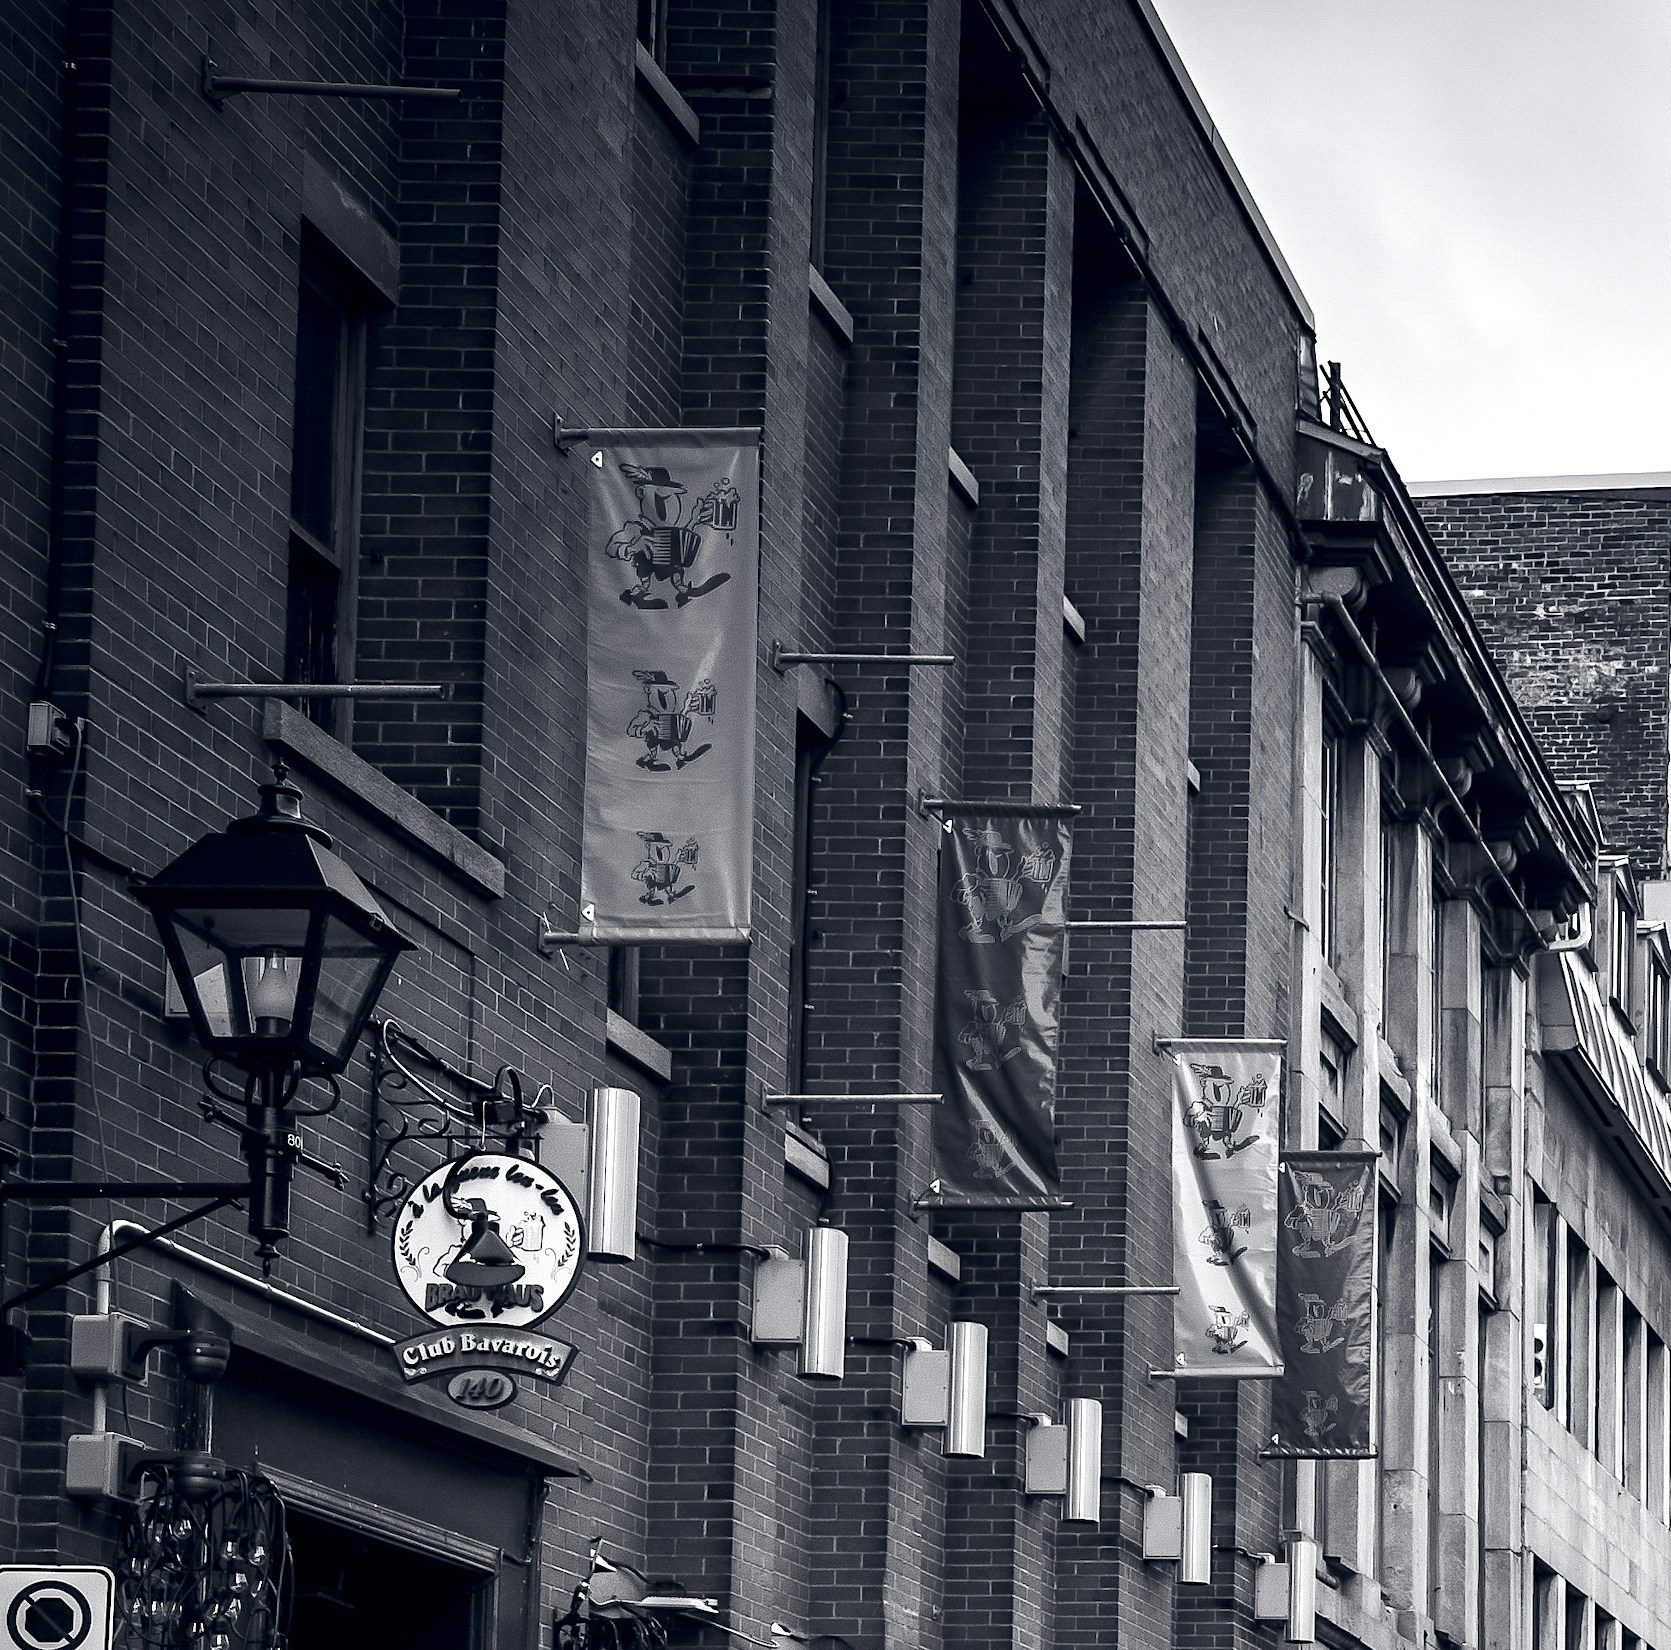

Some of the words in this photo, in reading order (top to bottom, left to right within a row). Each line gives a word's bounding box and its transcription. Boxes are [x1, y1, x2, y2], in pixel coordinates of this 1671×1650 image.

[402, 1333, 456, 1366] Club
[461, 1333, 562, 1369] Bavarois
[455, 1377, 505, 1401] 140
